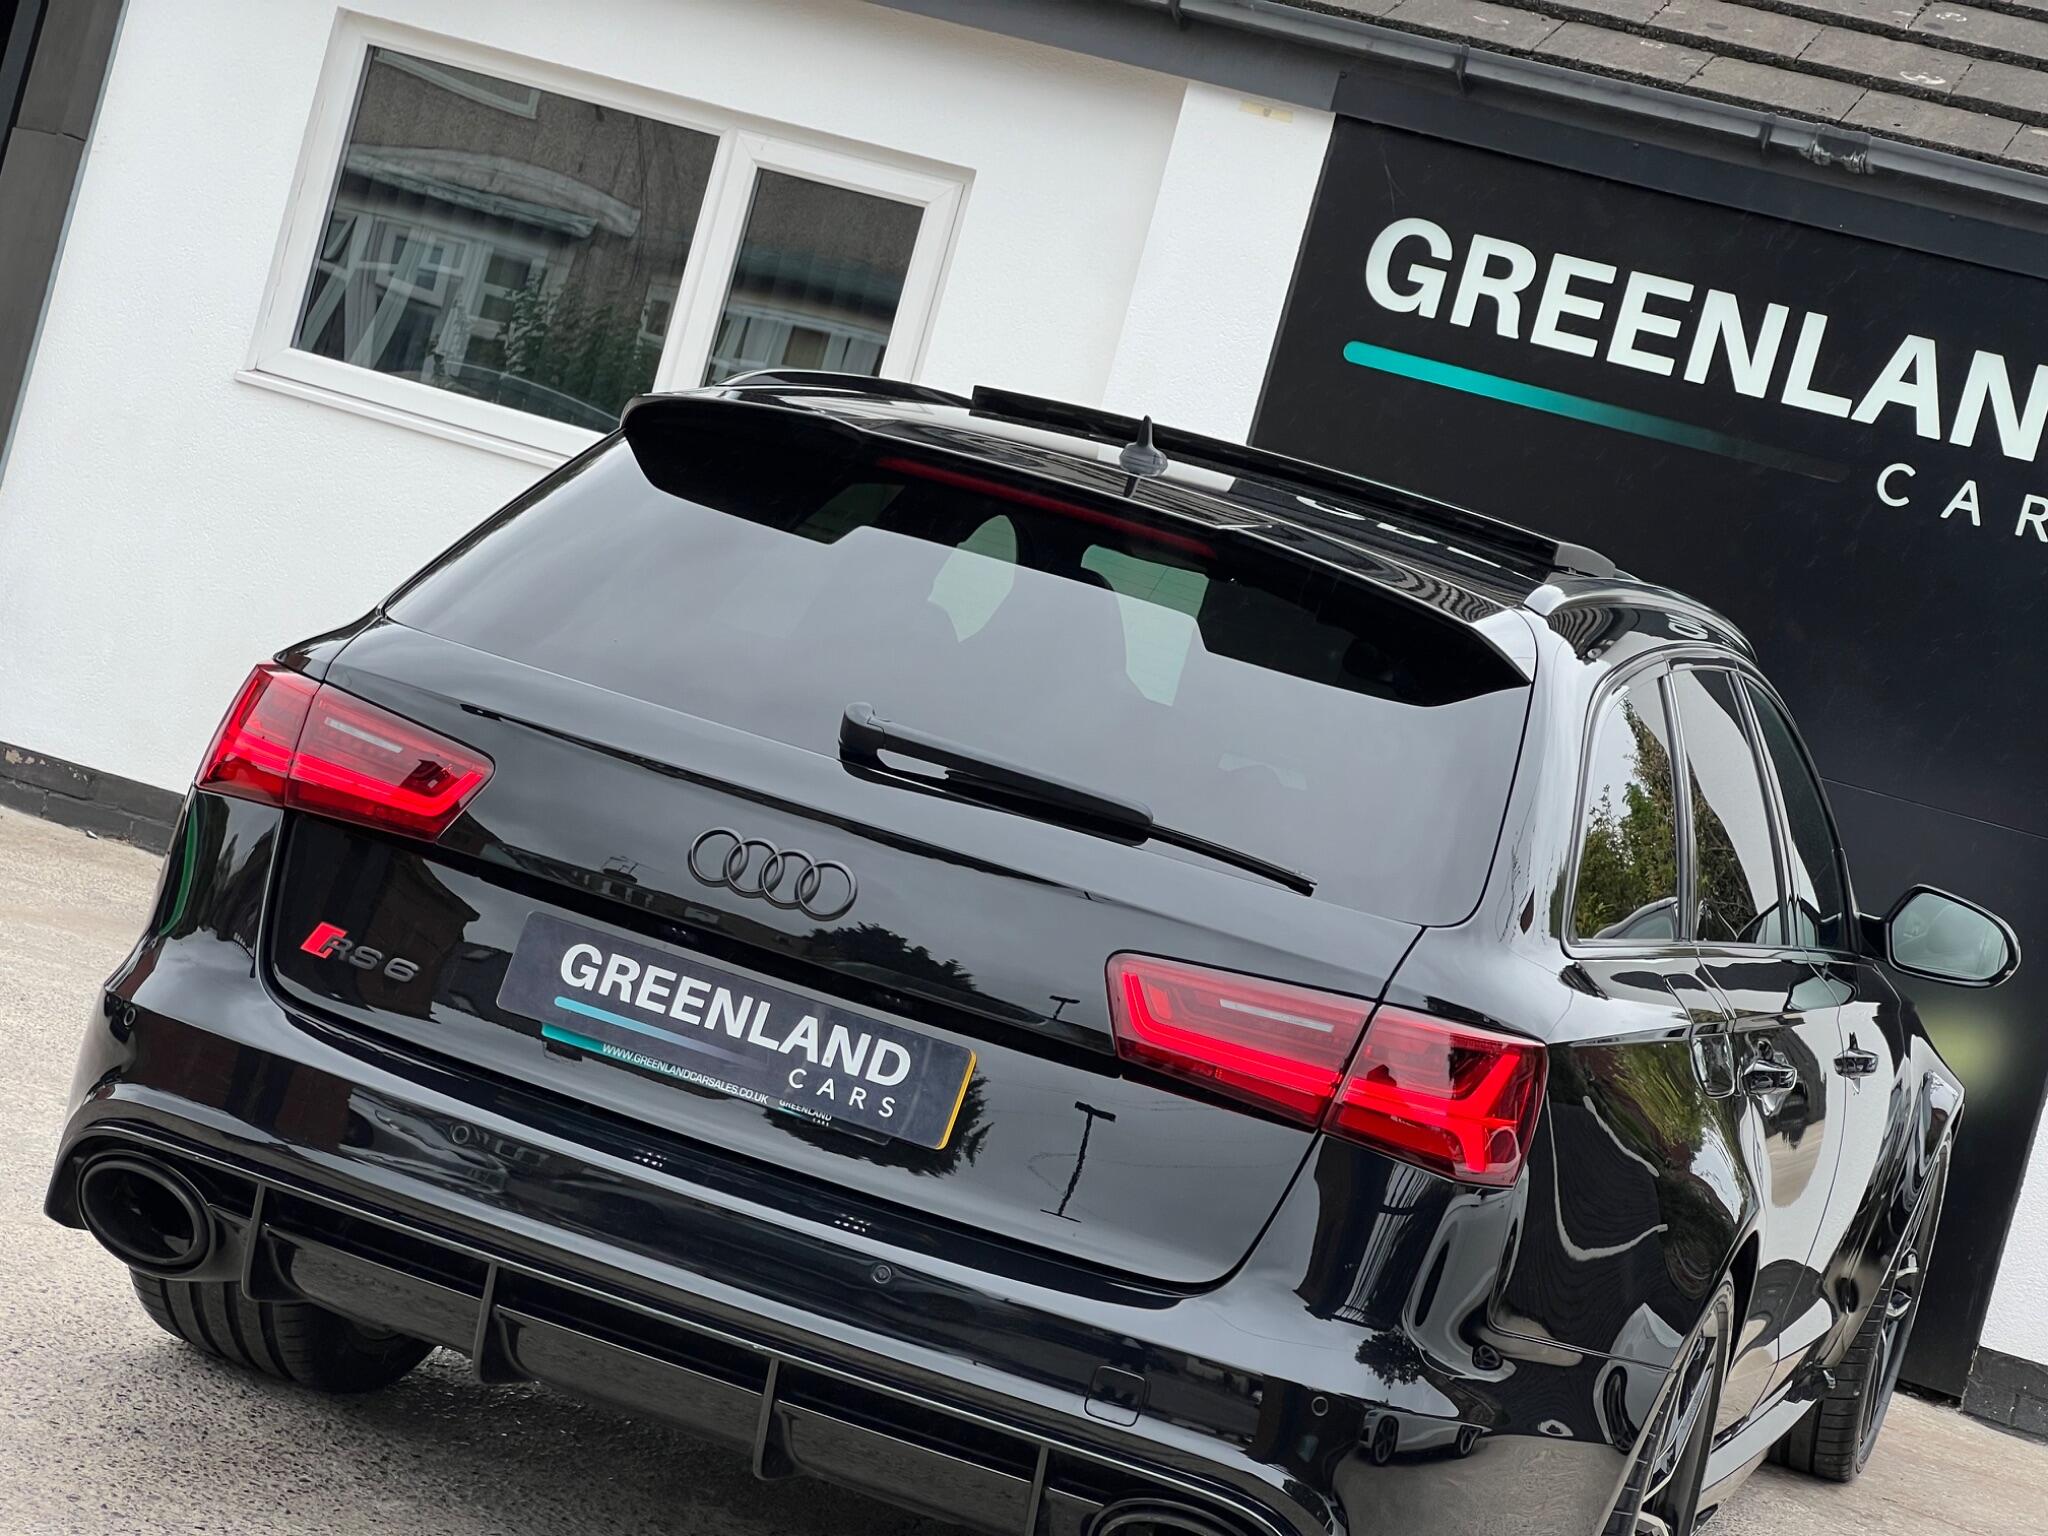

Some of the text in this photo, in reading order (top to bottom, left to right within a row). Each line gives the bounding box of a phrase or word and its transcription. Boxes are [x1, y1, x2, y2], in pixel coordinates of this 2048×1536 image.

[560, 943, 911, 1086] GREENLAND
[602, 1042, 769, 1105] WWW.GREENLANDCARSALES.CO.UK
[788, 1068, 896, 1118] CARS
